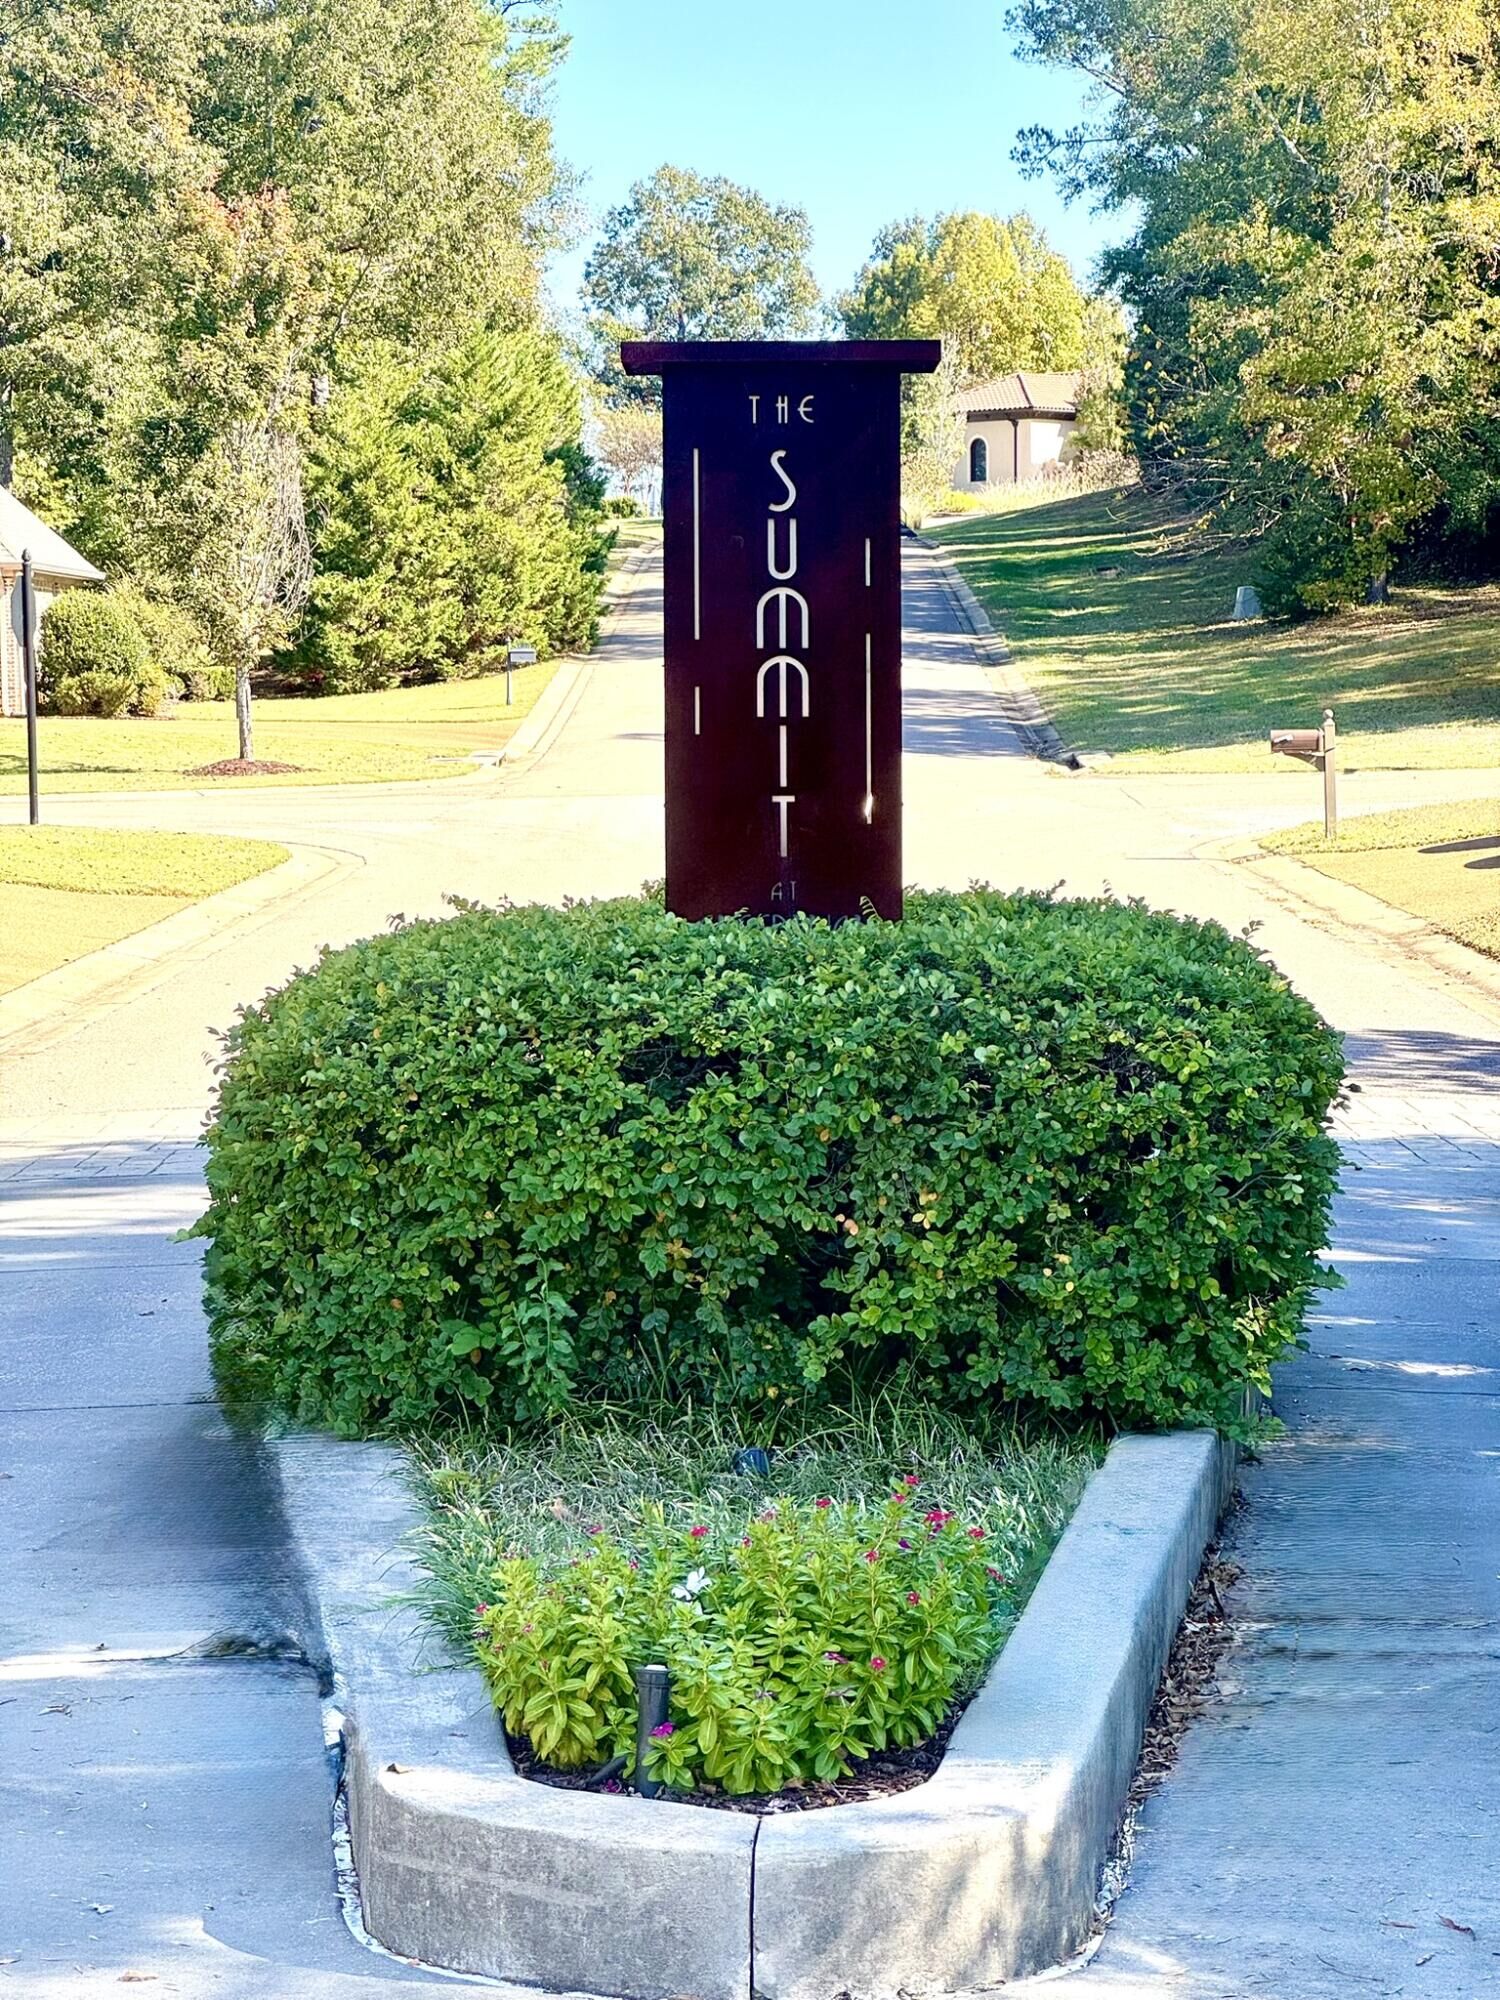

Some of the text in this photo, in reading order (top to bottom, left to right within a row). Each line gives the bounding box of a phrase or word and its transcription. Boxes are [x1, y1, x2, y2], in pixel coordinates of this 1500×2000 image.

[749, 395, 814, 424] THE
[756, 450, 809, 857] SUMMIT
[771, 881, 797, 901] AT
